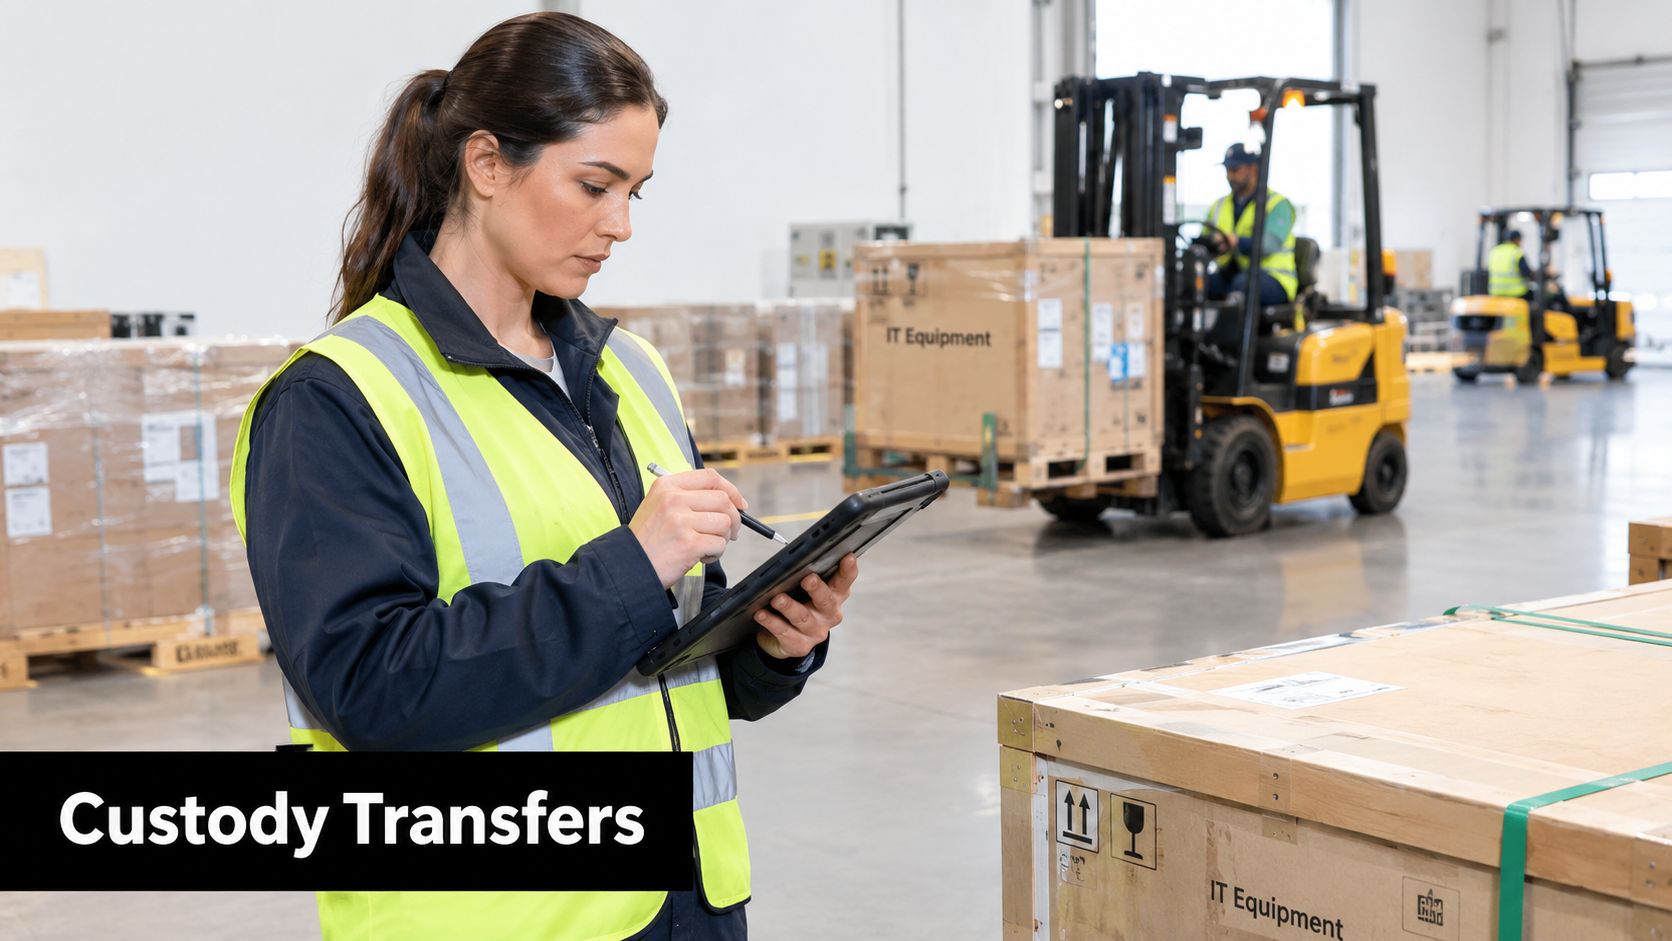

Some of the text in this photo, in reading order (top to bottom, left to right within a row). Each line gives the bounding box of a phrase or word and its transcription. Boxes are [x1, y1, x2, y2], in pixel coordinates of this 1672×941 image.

[886, 327, 991, 348] IT Equipment
[1210, 879, 1344, 941] IT Equipment
